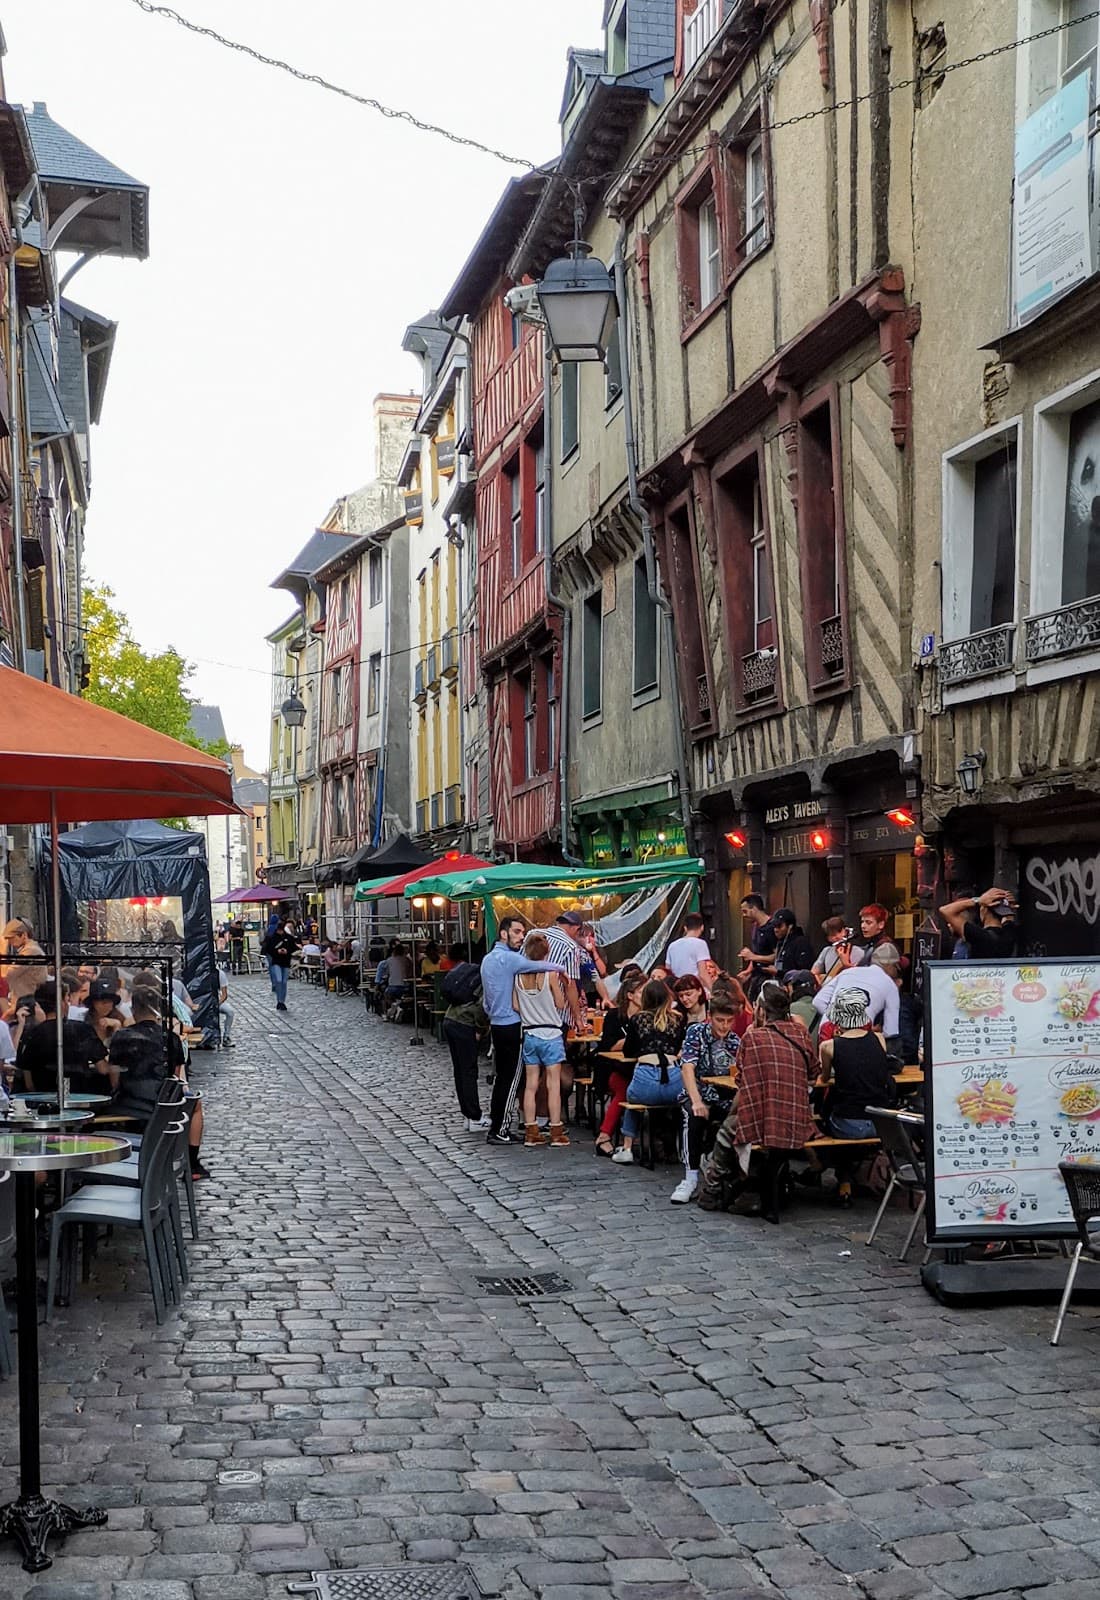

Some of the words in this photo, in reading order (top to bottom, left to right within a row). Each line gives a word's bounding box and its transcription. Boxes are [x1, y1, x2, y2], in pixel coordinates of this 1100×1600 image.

[924, 637, 930, 653] 8
[765, 805, 789, 824] ALEX'S
[793, 801, 821, 818] TAVERN
[773, 837, 785, 857] LA
[961, 1065, 1008, 1087] Burgers
[968, 1181, 1015, 1198] Desserts
